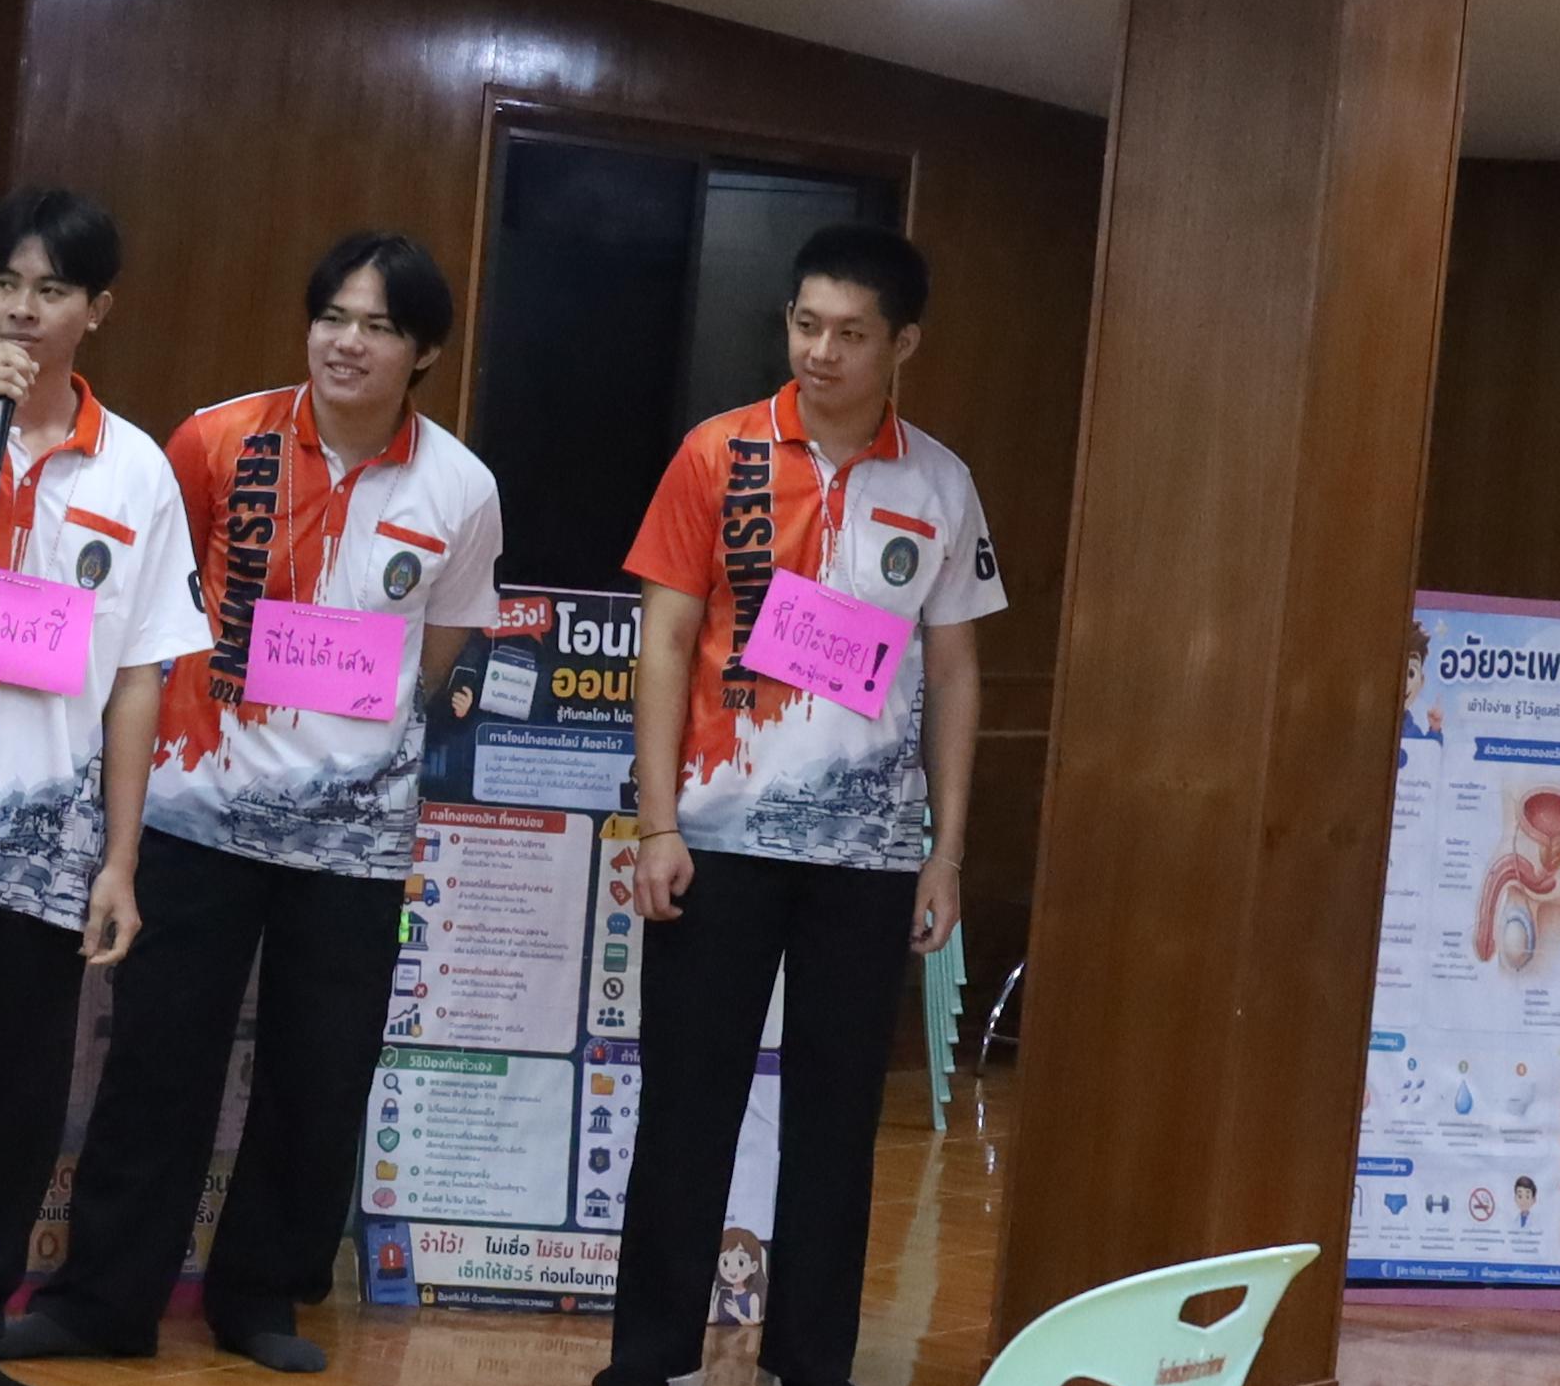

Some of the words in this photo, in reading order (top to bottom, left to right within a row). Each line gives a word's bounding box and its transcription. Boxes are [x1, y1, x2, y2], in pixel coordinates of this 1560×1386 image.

[419, 1230, 464, 1255] จำไว้!
[485, 1234, 530, 1256] ไม่เชื่อ
[536, 1239, 574, 1259] ไม่รีบ
[539, 1266, 618, 1291] ก่อนโอนทุก
